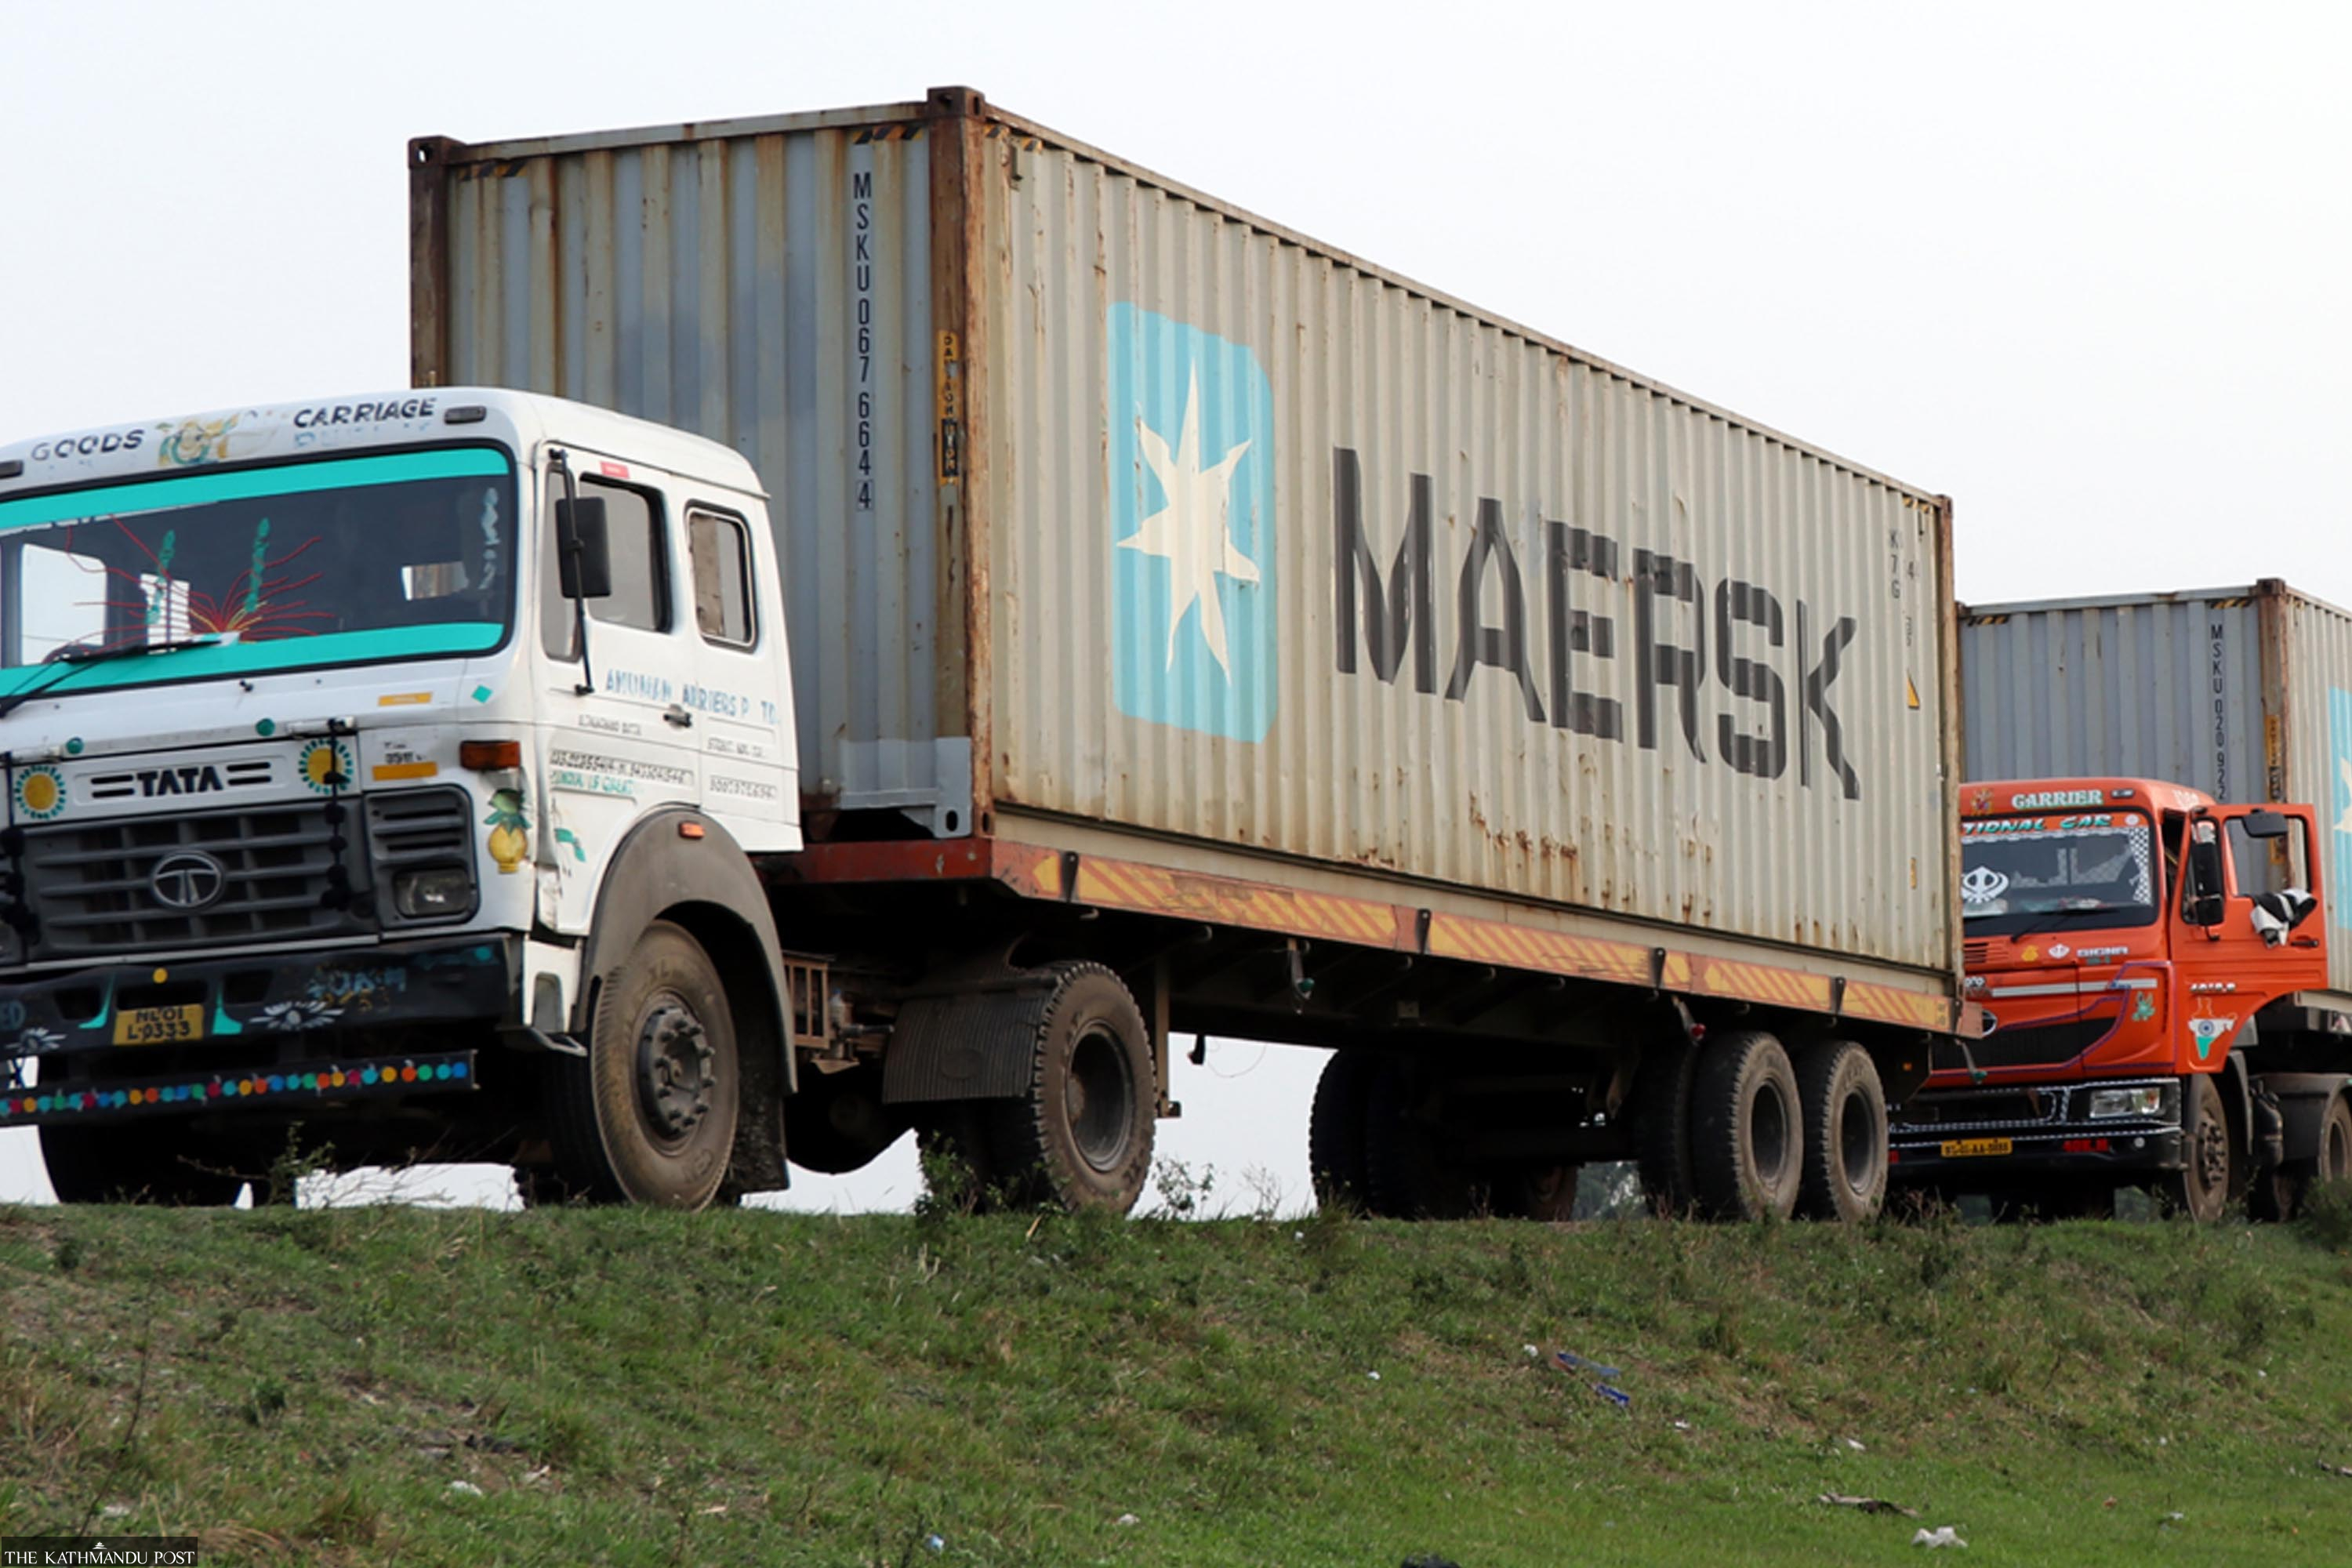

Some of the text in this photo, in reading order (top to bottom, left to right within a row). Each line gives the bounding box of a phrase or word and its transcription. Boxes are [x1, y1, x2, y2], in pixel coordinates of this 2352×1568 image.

[31, 397, 437, 461] GOODS CARRIAGE
[1333, 446, 1860, 800] MAERSK
[136, 765, 224, 797] TATA
[1962, 818, 2046, 834] TIONAL
